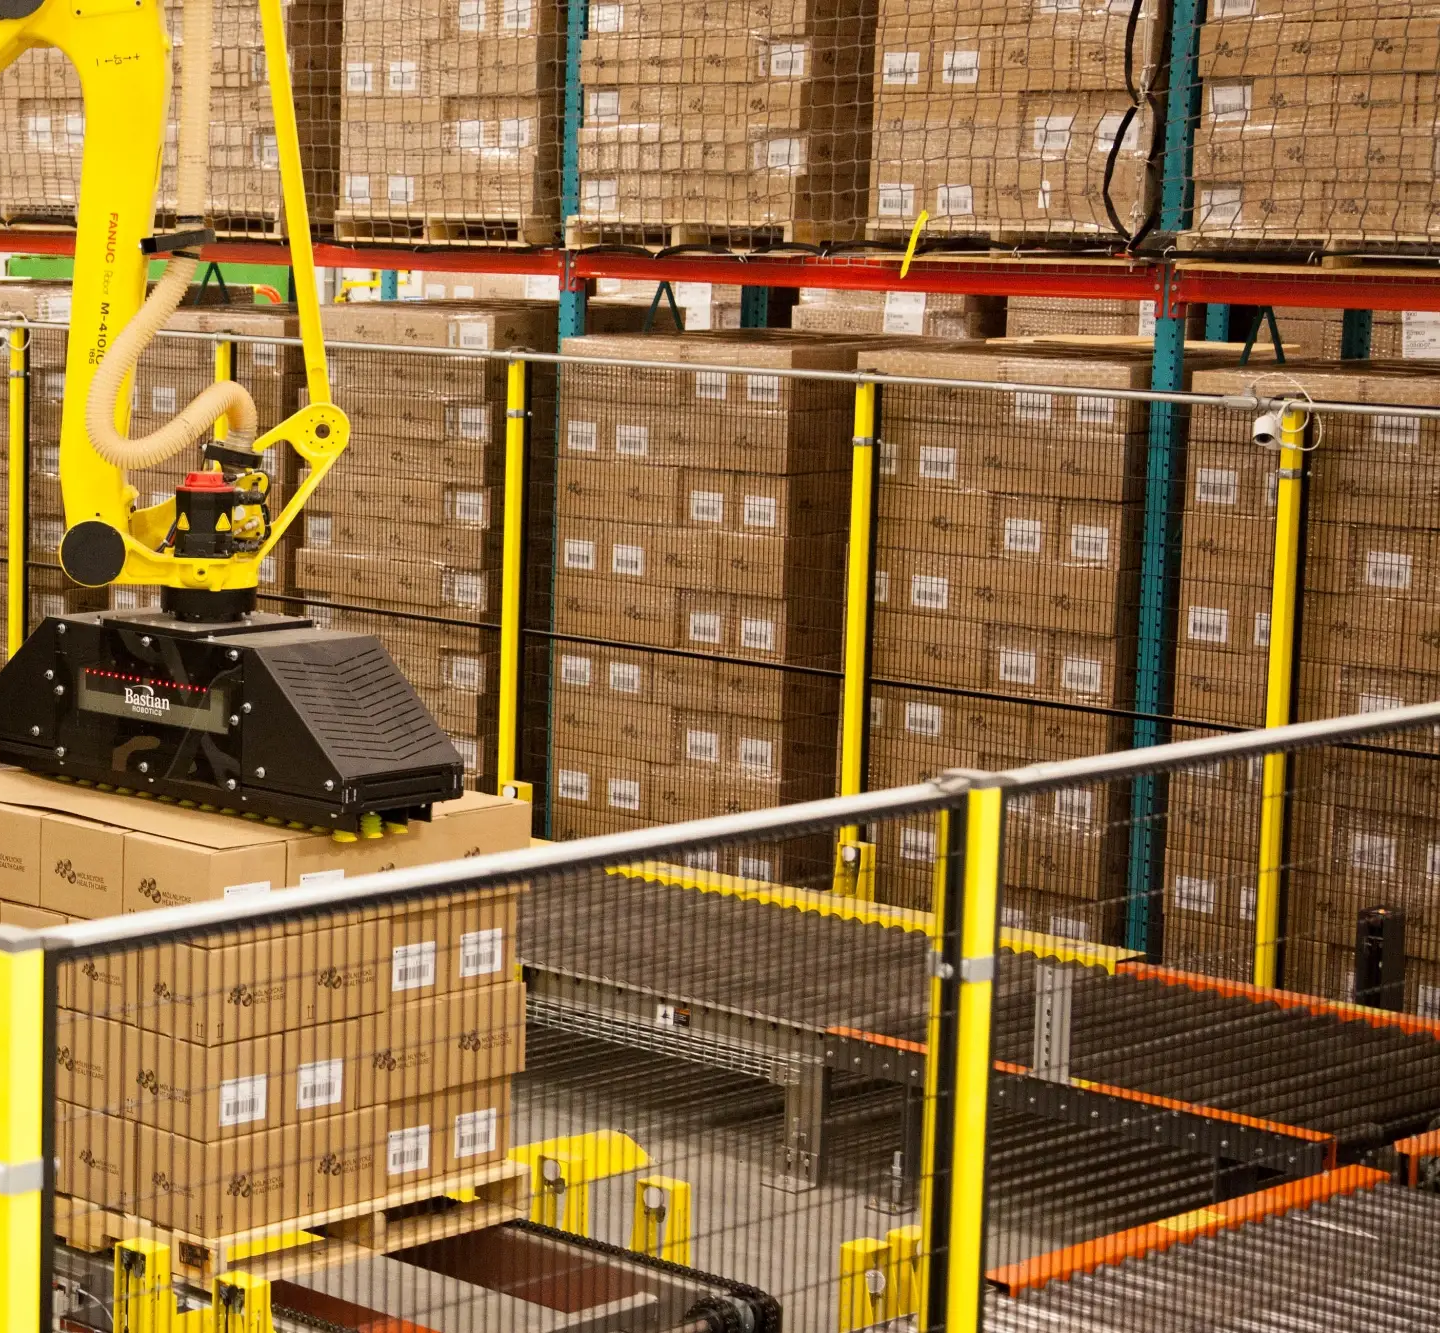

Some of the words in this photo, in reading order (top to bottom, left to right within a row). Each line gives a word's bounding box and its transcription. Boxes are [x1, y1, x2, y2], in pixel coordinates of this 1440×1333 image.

[104, 212, 119, 264] FANUC
[101, 270, 114, 295] Robot
[88, 348, 96, 365] 185
[124, 687, 171, 711] Bastian
[131, 704, 163, 717] ROBOTICS
